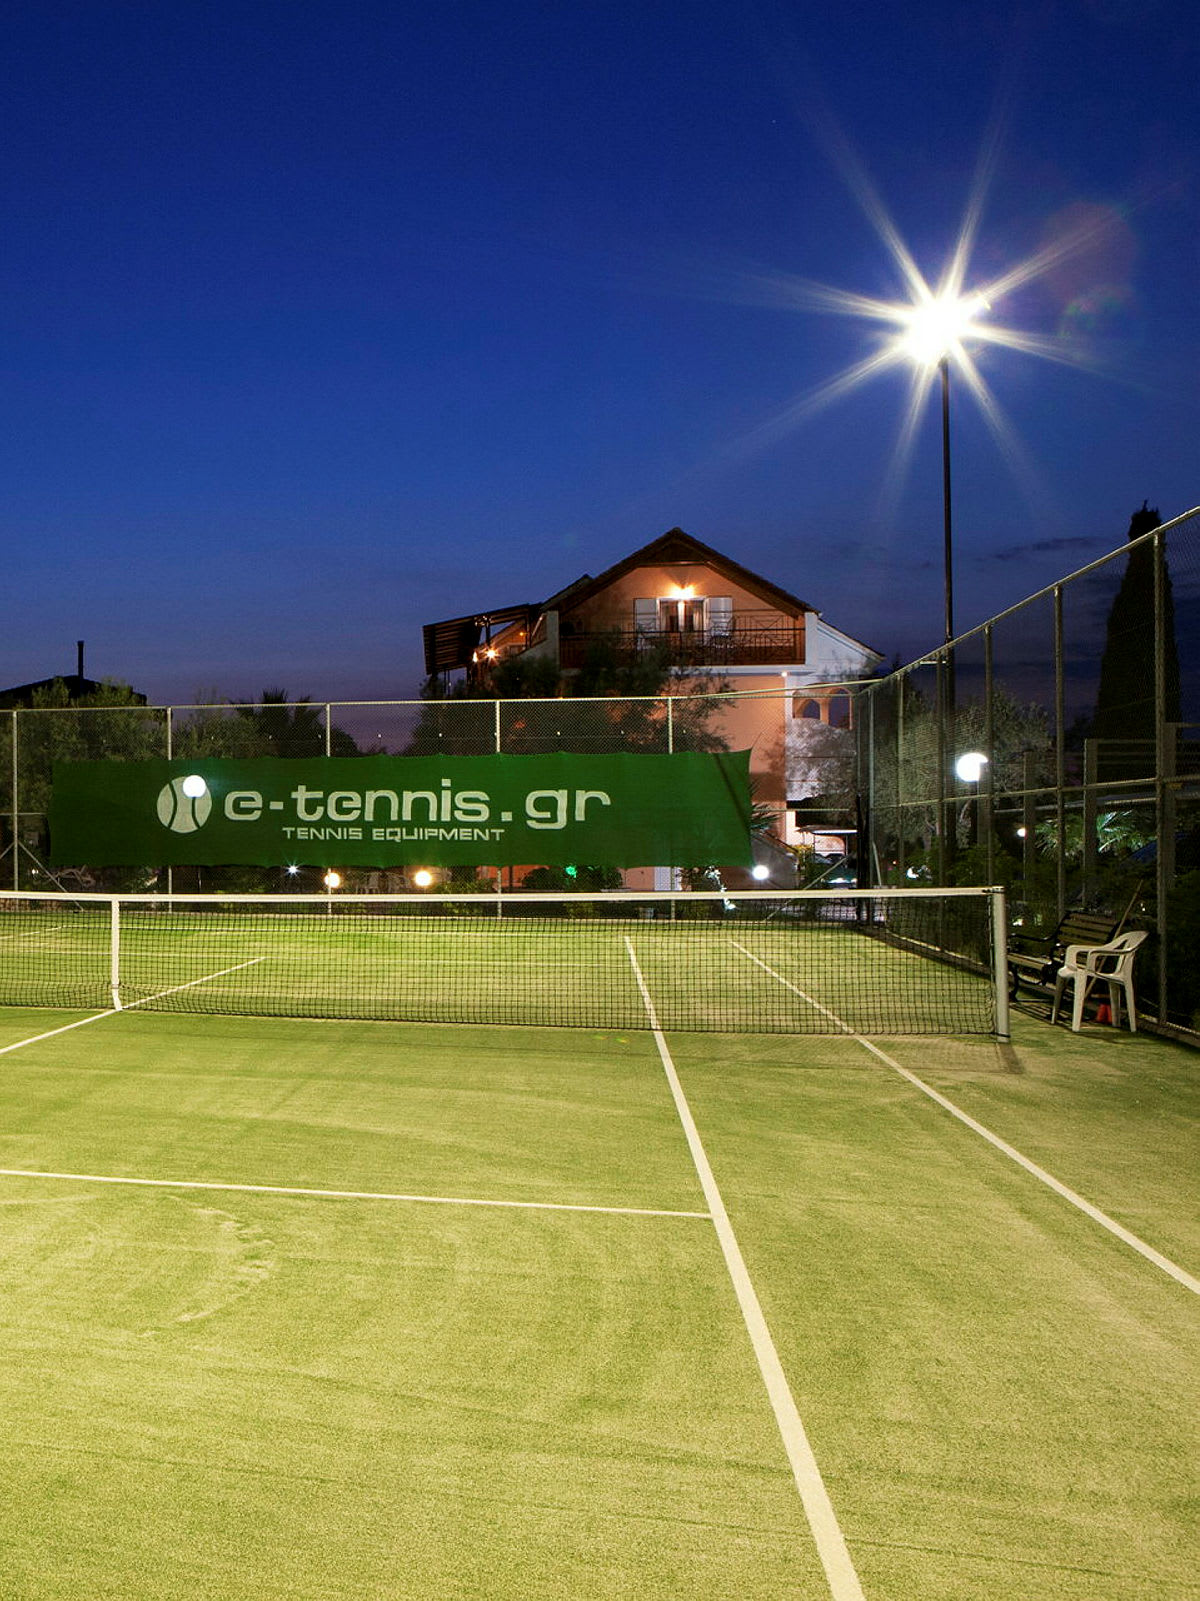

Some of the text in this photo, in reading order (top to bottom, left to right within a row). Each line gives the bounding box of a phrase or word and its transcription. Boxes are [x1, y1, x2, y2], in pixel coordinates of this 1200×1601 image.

[224, 778, 611, 829] e-tennis.gr
[282, 827, 505, 842] TENNIS EQUIPMENT
